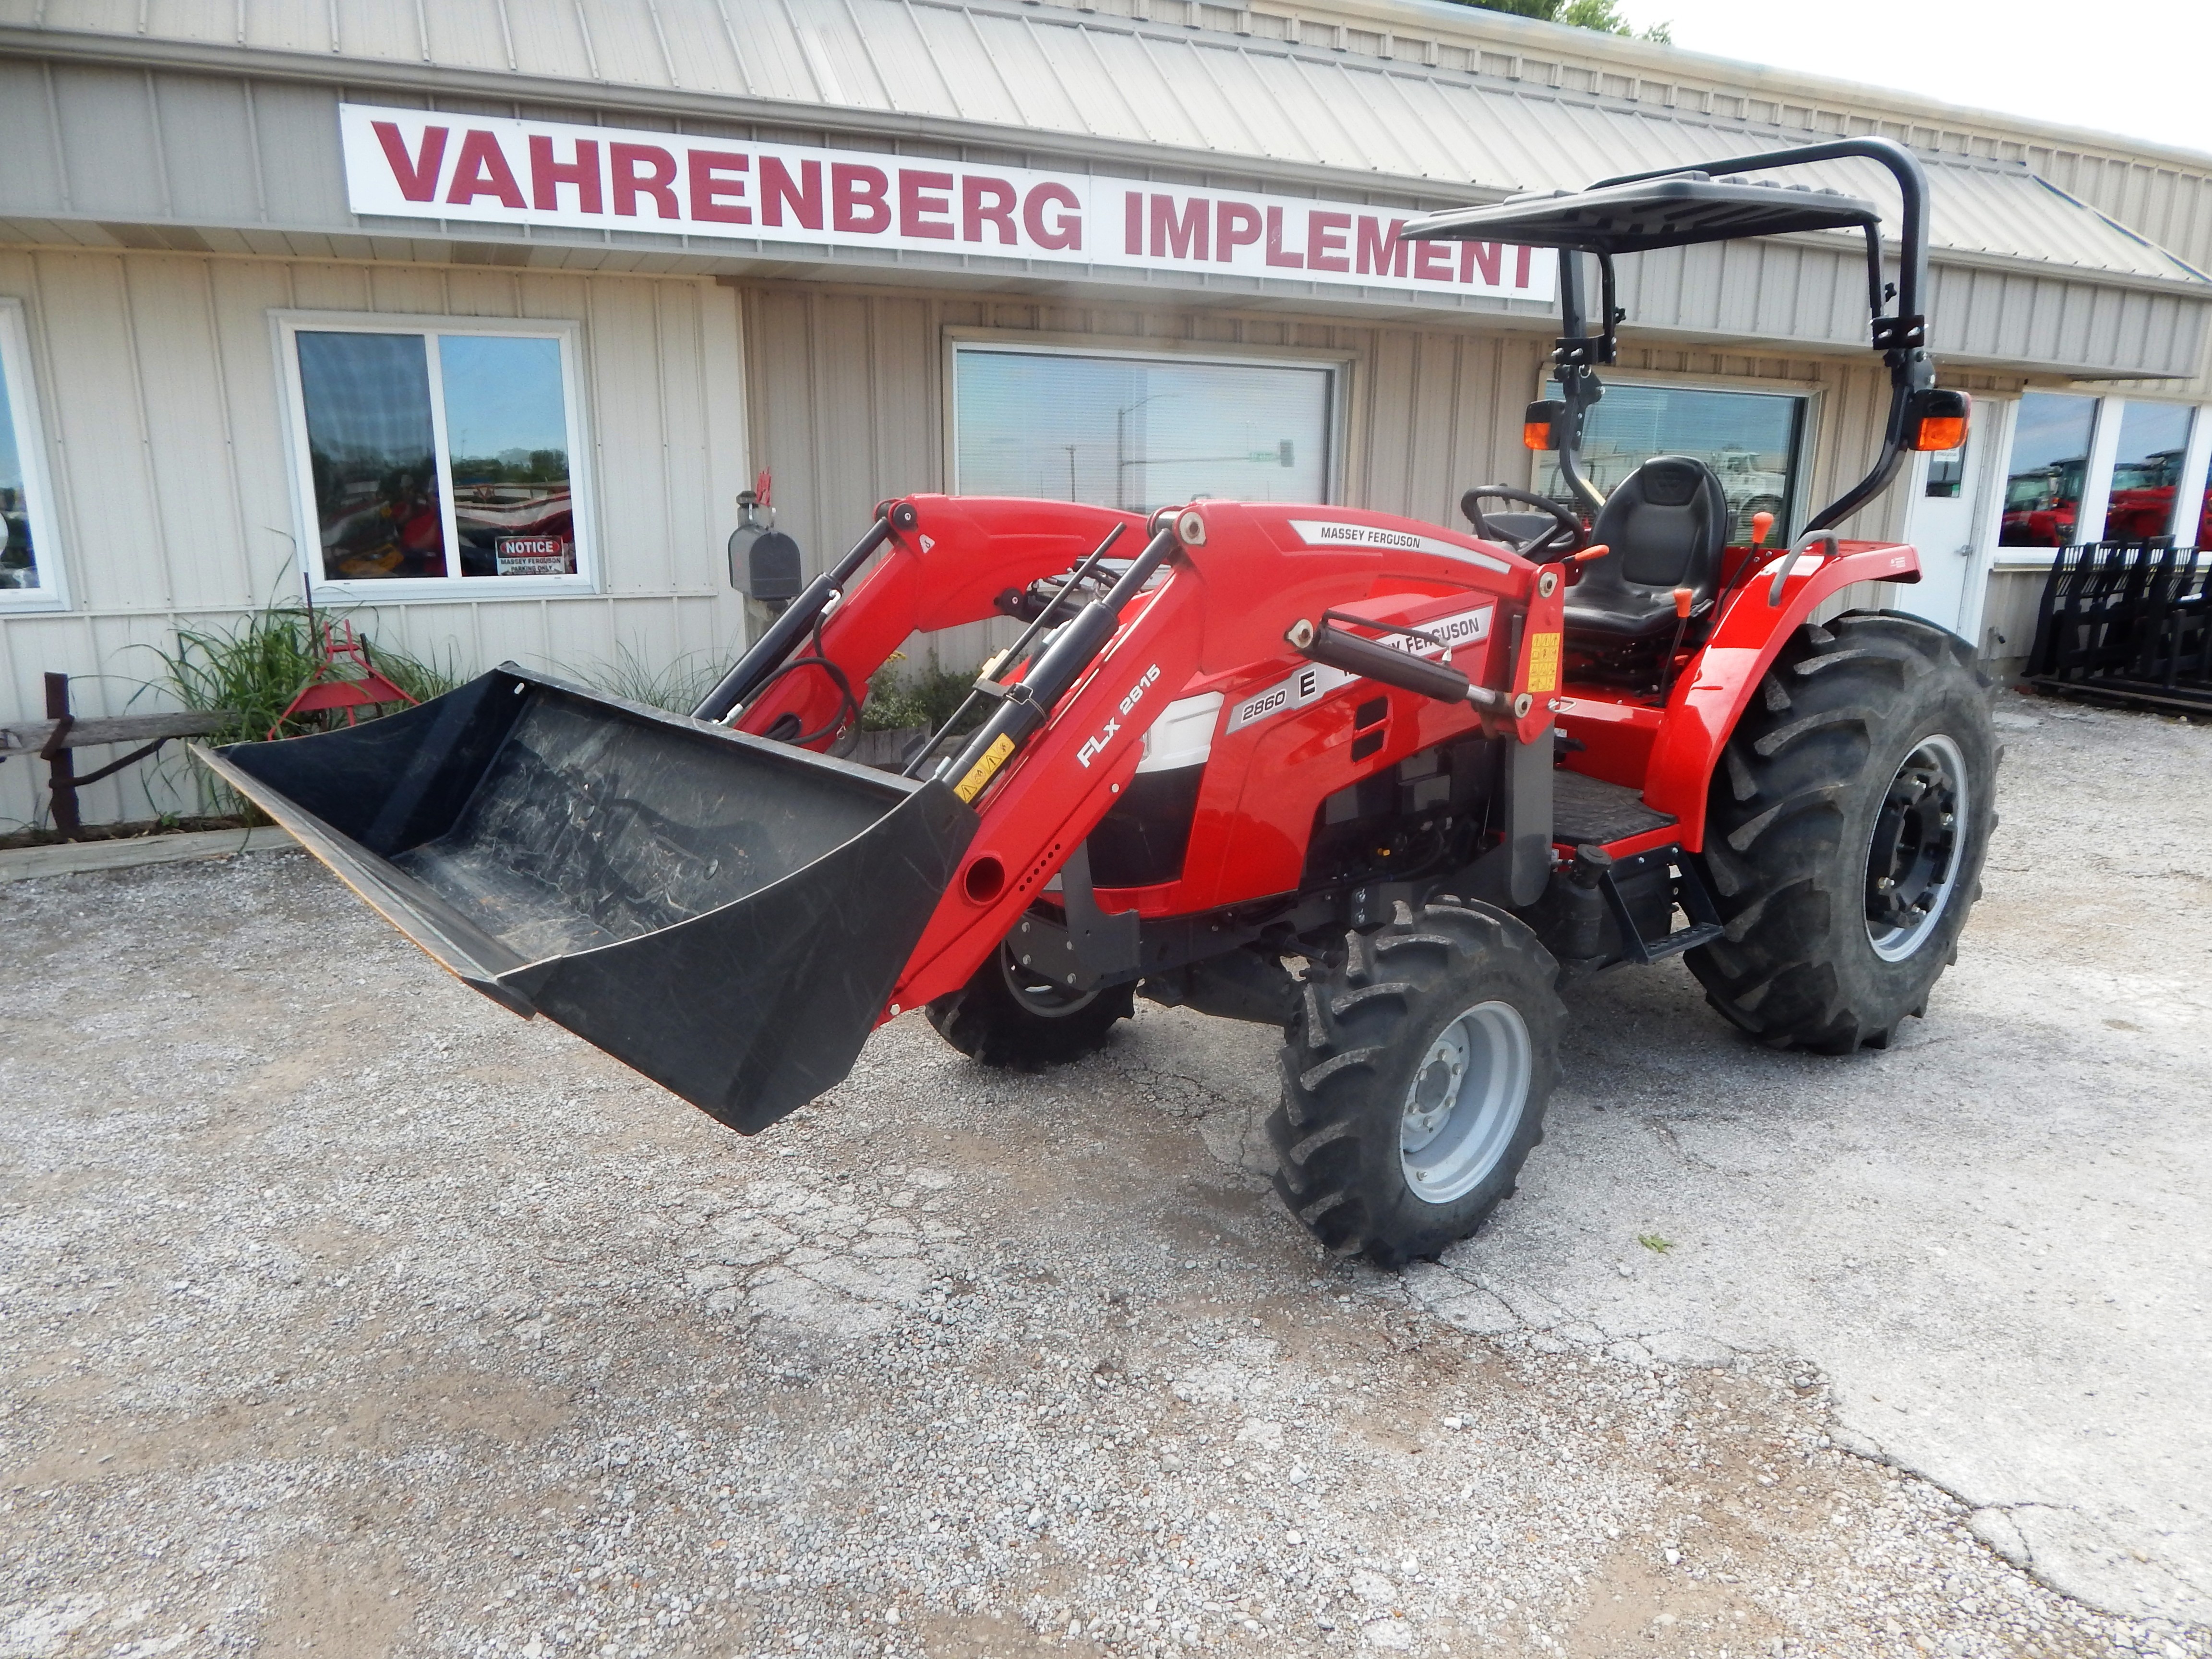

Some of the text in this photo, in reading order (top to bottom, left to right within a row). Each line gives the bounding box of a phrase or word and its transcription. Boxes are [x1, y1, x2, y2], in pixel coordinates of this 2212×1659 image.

[371, 121, 1544, 288] VAHRENBERG IMPLEMENT
[506, 541, 554, 553] NOTICE
[1321, 527, 1421, 548] MASSEY FERGUSON
[1076, 663, 1161, 768] FLX 2815
[1243, 671, 1316, 721] 2860 E
